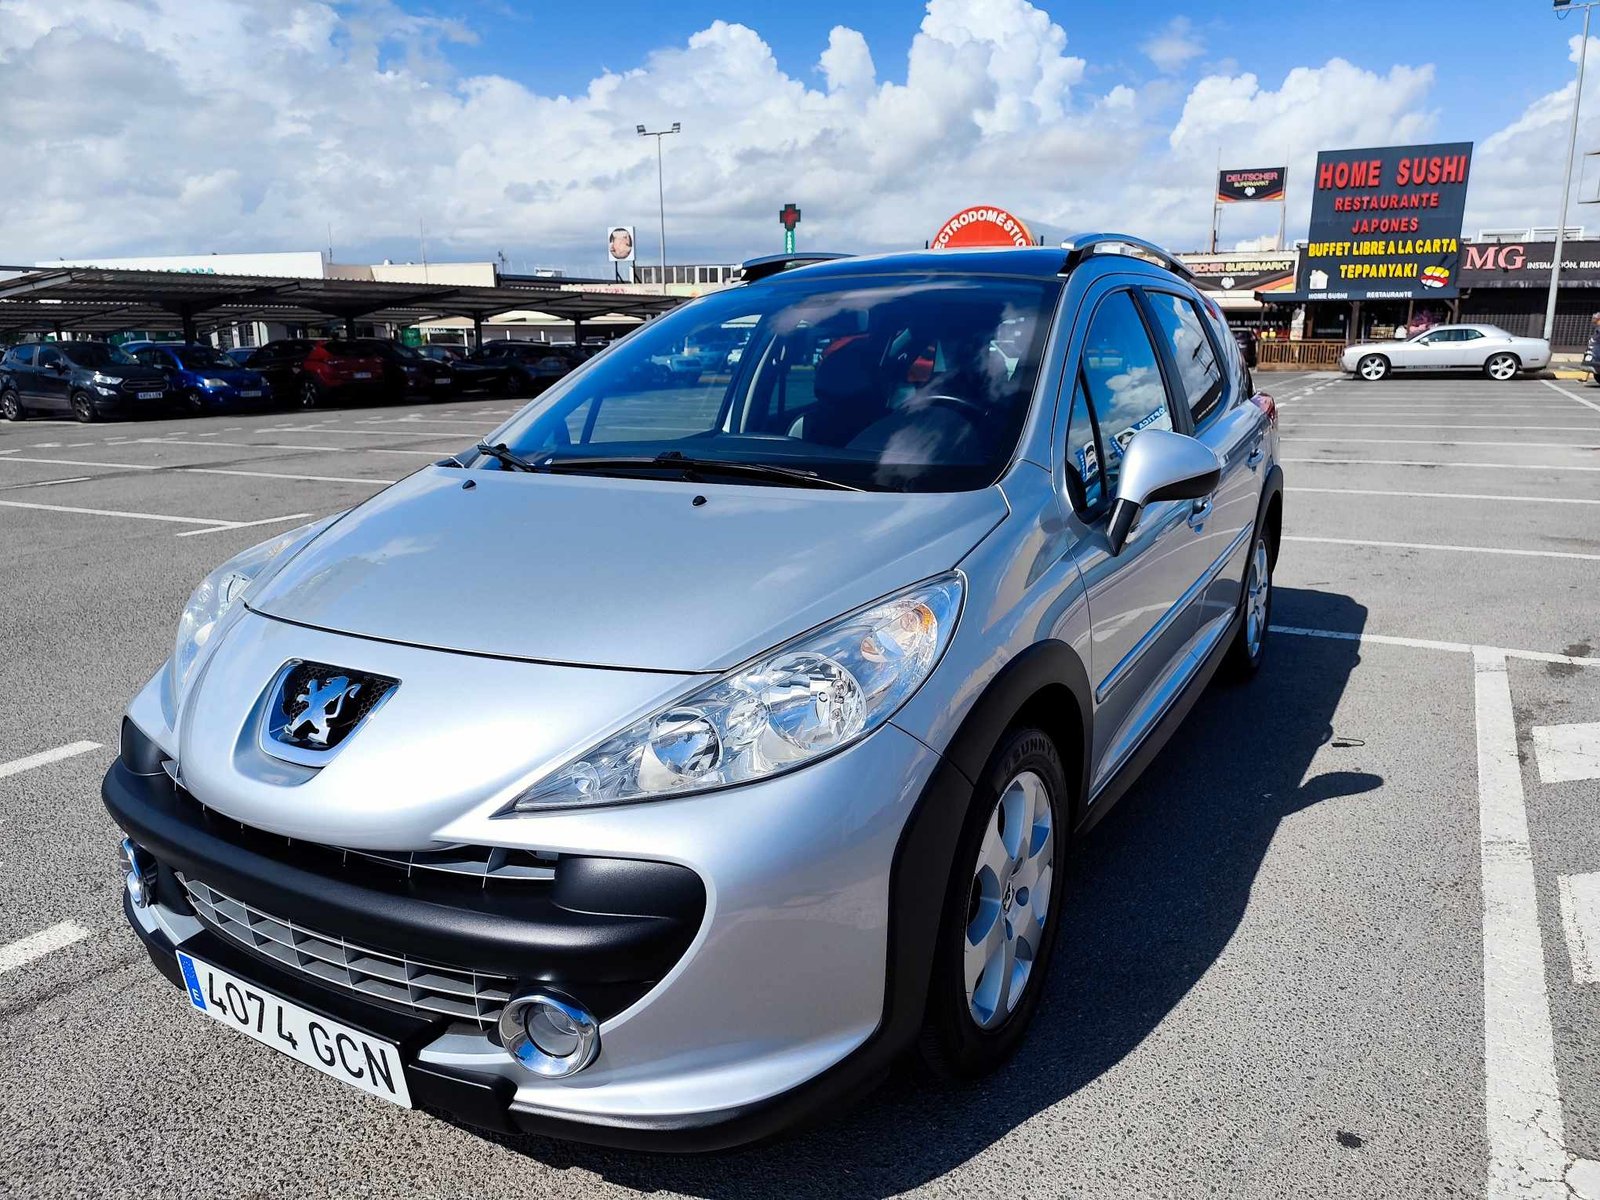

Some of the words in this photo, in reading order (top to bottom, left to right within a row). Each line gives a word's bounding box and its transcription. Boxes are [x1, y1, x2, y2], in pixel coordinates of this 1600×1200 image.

[1226, 171, 1278, 183] DEUTSCHER
[1318, 160, 1382, 190] HOME
[1396, 154, 1468, 186] SUSHI
[1334, 192, 1440, 212] RESTAURANTE
[1351, 216, 1419, 234] JAPONES
[1308, 241, 1351, 257] BUFFET
[1352, 240, 1386, 256] LIBRE
[1387, 240, 1395, 255] A
[1397, 240, 1414, 254] LA
[1415, 238, 1457, 254] CARTA
[1225, 261, 1292, 272] SUPERMARKT
[1463, 245, 1527, 270] MG
[1339, 263, 1418, 279] TEPPANYAKI
[1366, 291, 1413, 299] RESTAURANTE
[192, 989, 202, 1002] E
[208, 972, 298, 1051] 4074
[308, 1021, 396, 1095] GCN
